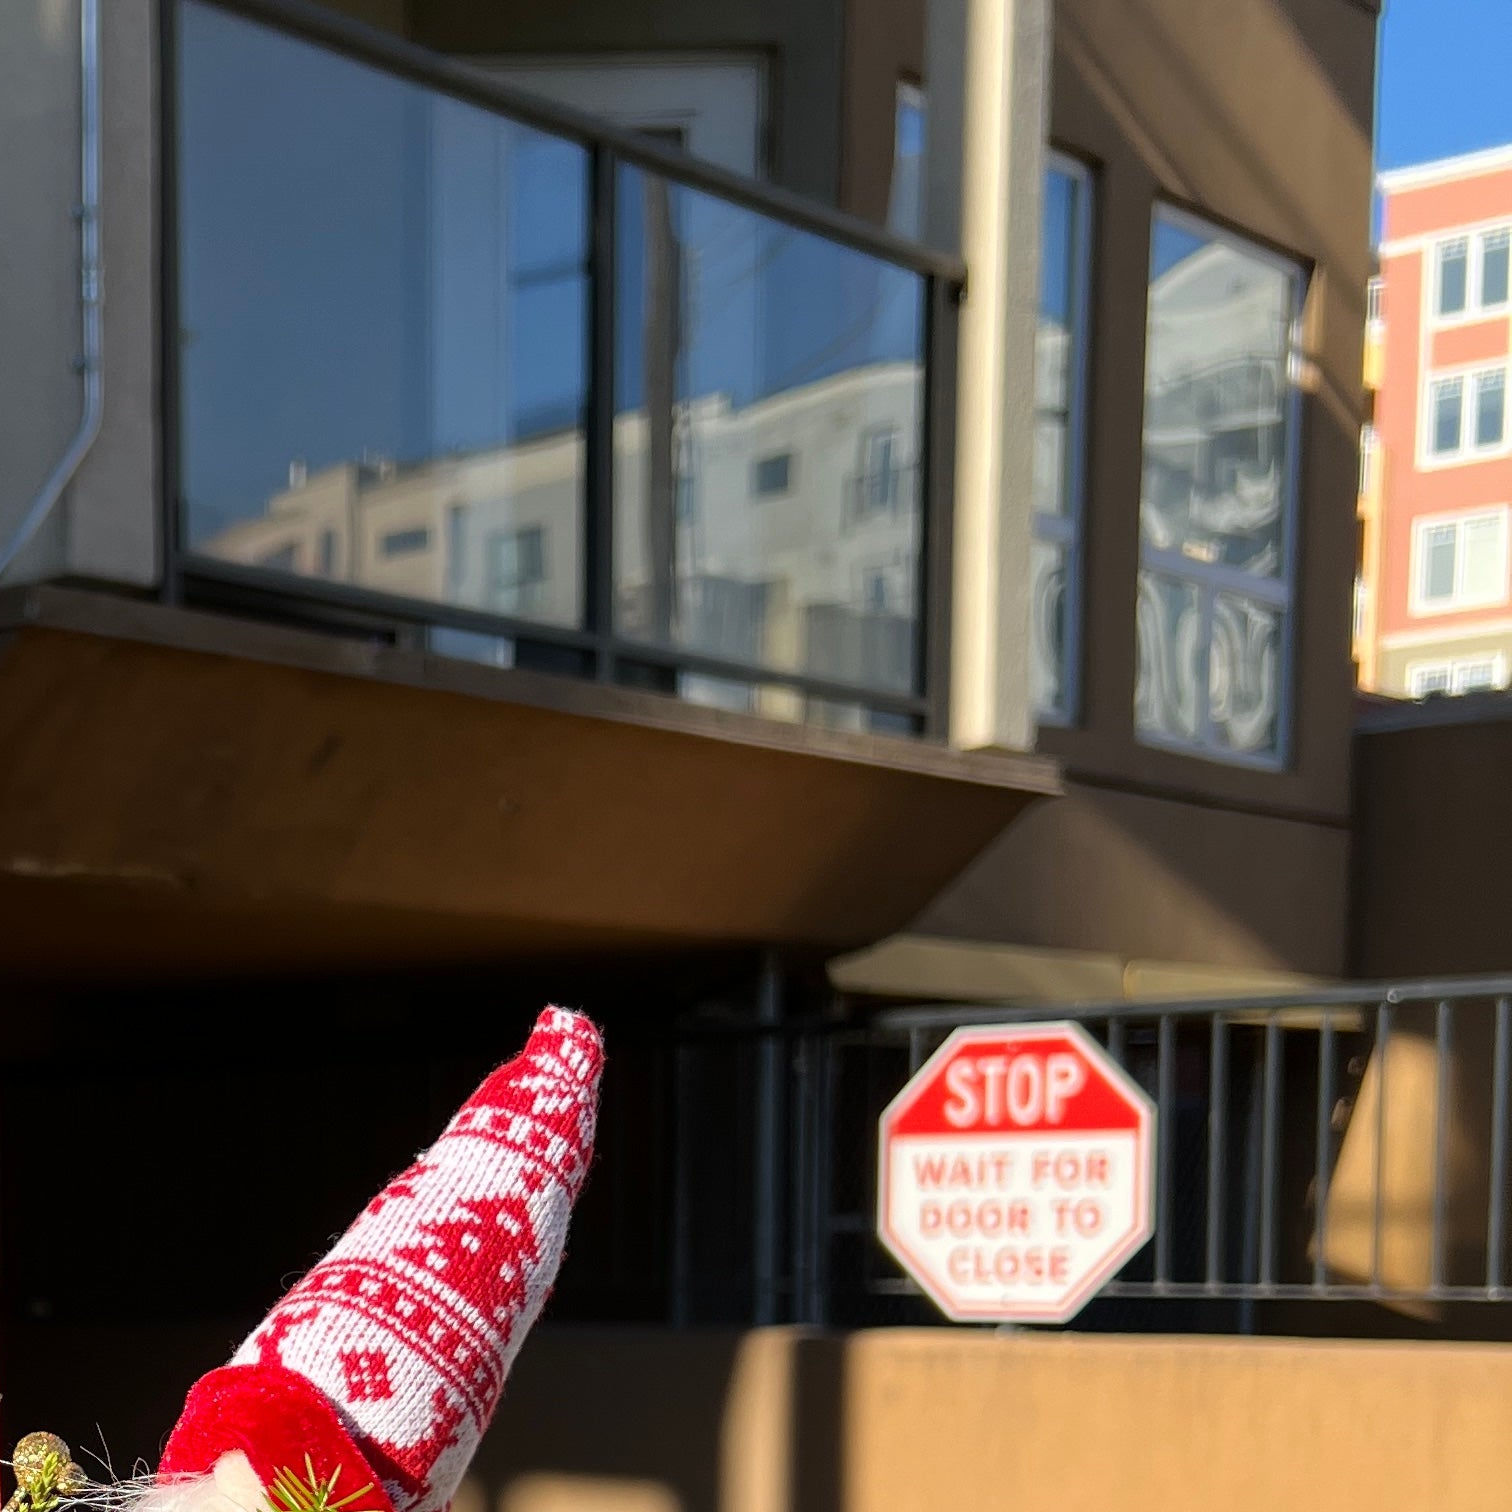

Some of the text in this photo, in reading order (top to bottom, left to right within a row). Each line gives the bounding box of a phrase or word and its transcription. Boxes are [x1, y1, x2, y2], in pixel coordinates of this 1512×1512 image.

[943, 1053, 1086, 1128] STOP
[913, 1150, 1110, 1189] WAIT FOR
[919, 1198, 1104, 1238] DOOR TO
[947, 1247, 1070, 1284] CLOSE
